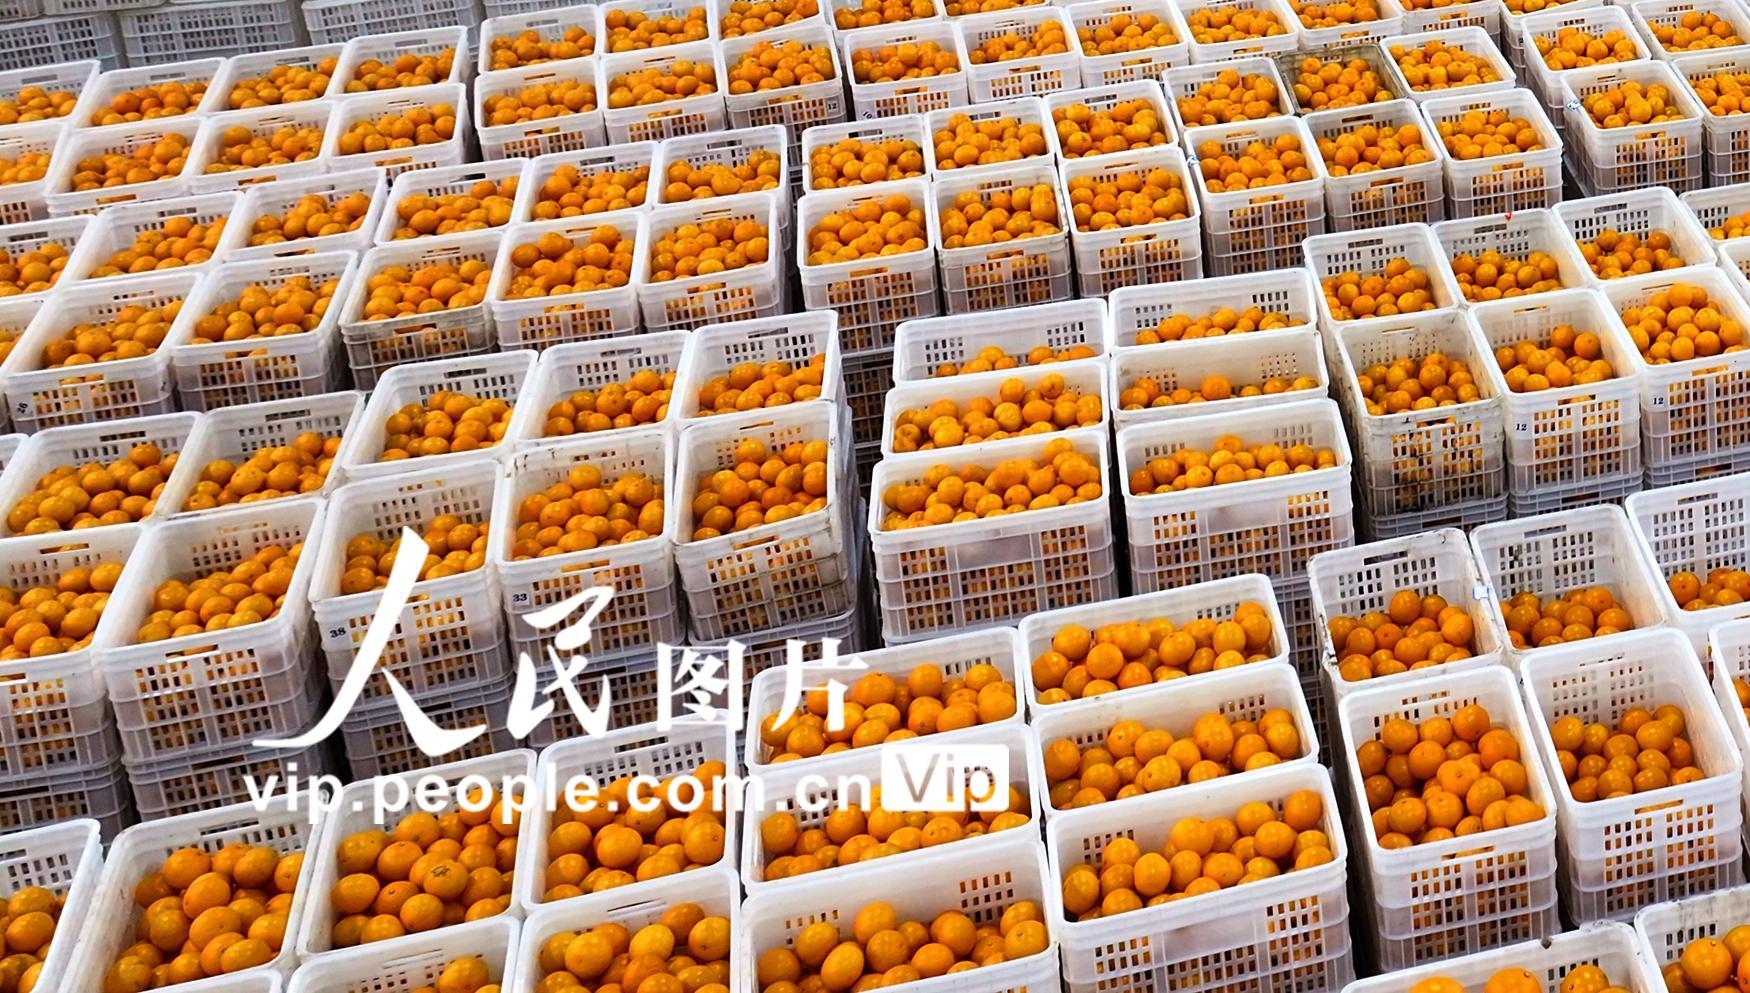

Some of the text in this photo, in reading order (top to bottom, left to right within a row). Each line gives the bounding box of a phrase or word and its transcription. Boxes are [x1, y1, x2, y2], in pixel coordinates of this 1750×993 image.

[1653, 397, 1663, 405] 12
[1516, 423, 1527, 431] 12
[513, 593, 528, 602] 33
[330, 627, 346, 638] 38
